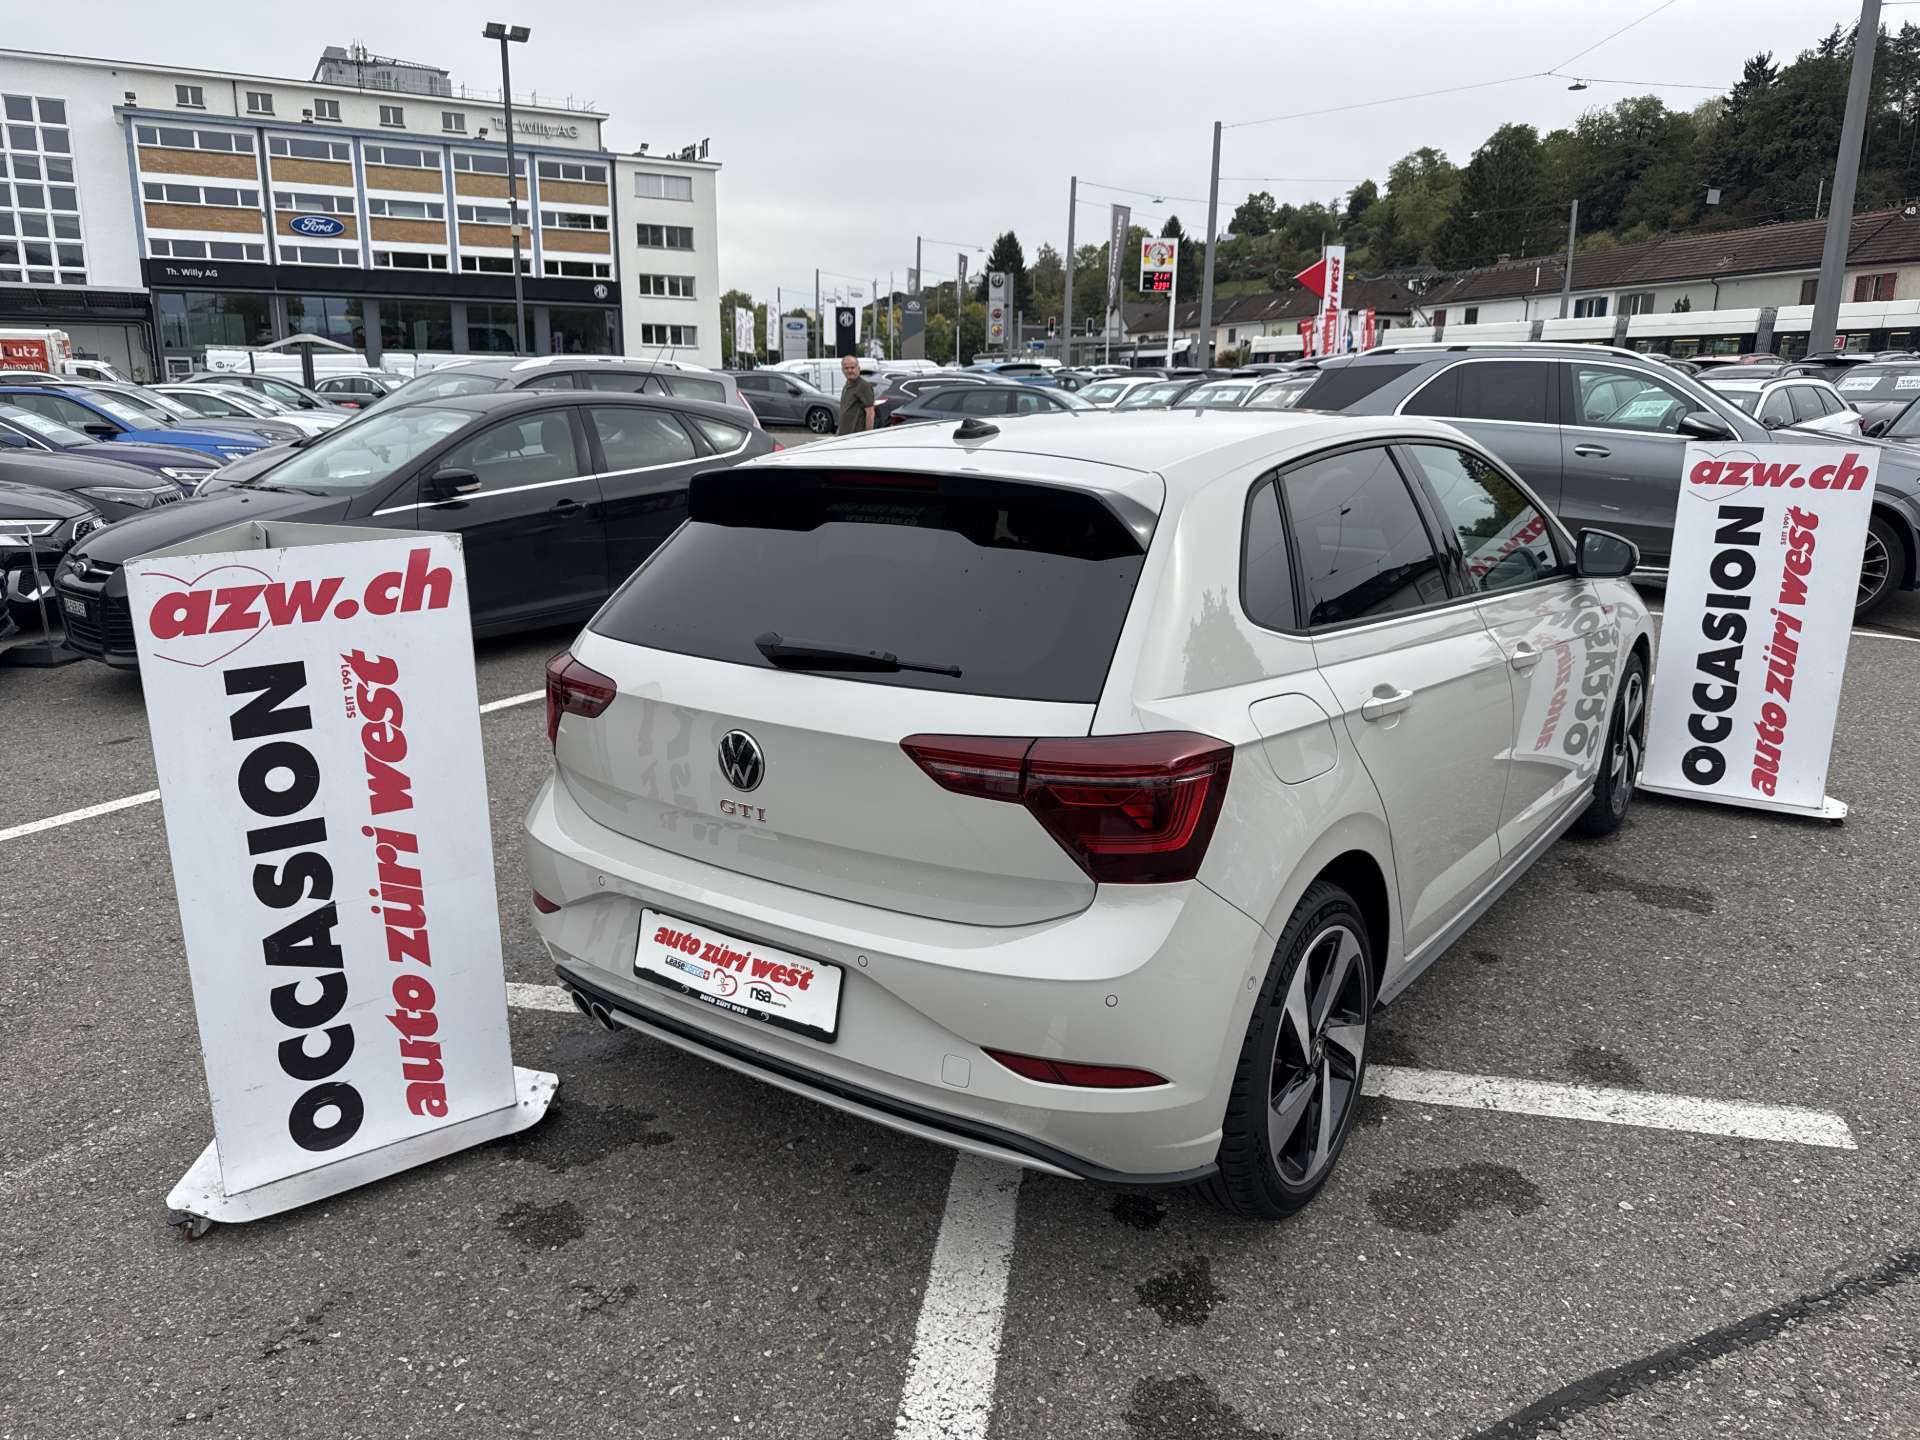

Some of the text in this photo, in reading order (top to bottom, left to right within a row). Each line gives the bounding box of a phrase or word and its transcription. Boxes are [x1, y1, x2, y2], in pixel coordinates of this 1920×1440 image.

[518, 119, 553, 139] Willy
[557, 123, 578, 139] AG
[1904, 206, 1917, 215] 48
[165, 267, 218, 279] Th. Willy AG
[1688, 453, 1869, 491] azw.ch
[148, 547, 453, 641] azw.ch
[1681, 505, 1765, 786] OCCASION
[1751, 505, 1820, 797] auto züri west
[340, 664, 357, 719] SEIT 1991
[720, 799, 767, 823] GTI
[223, 660, 365, 1153] OCCASION
[340, 648, 449, 1119] auto züri west
[654, 926, 814, 991] auto züri west
[699, 993, 715, 1004] auto
[731, 1004, 749, 1015] west
[750, 987, 772, 1003] nsa
